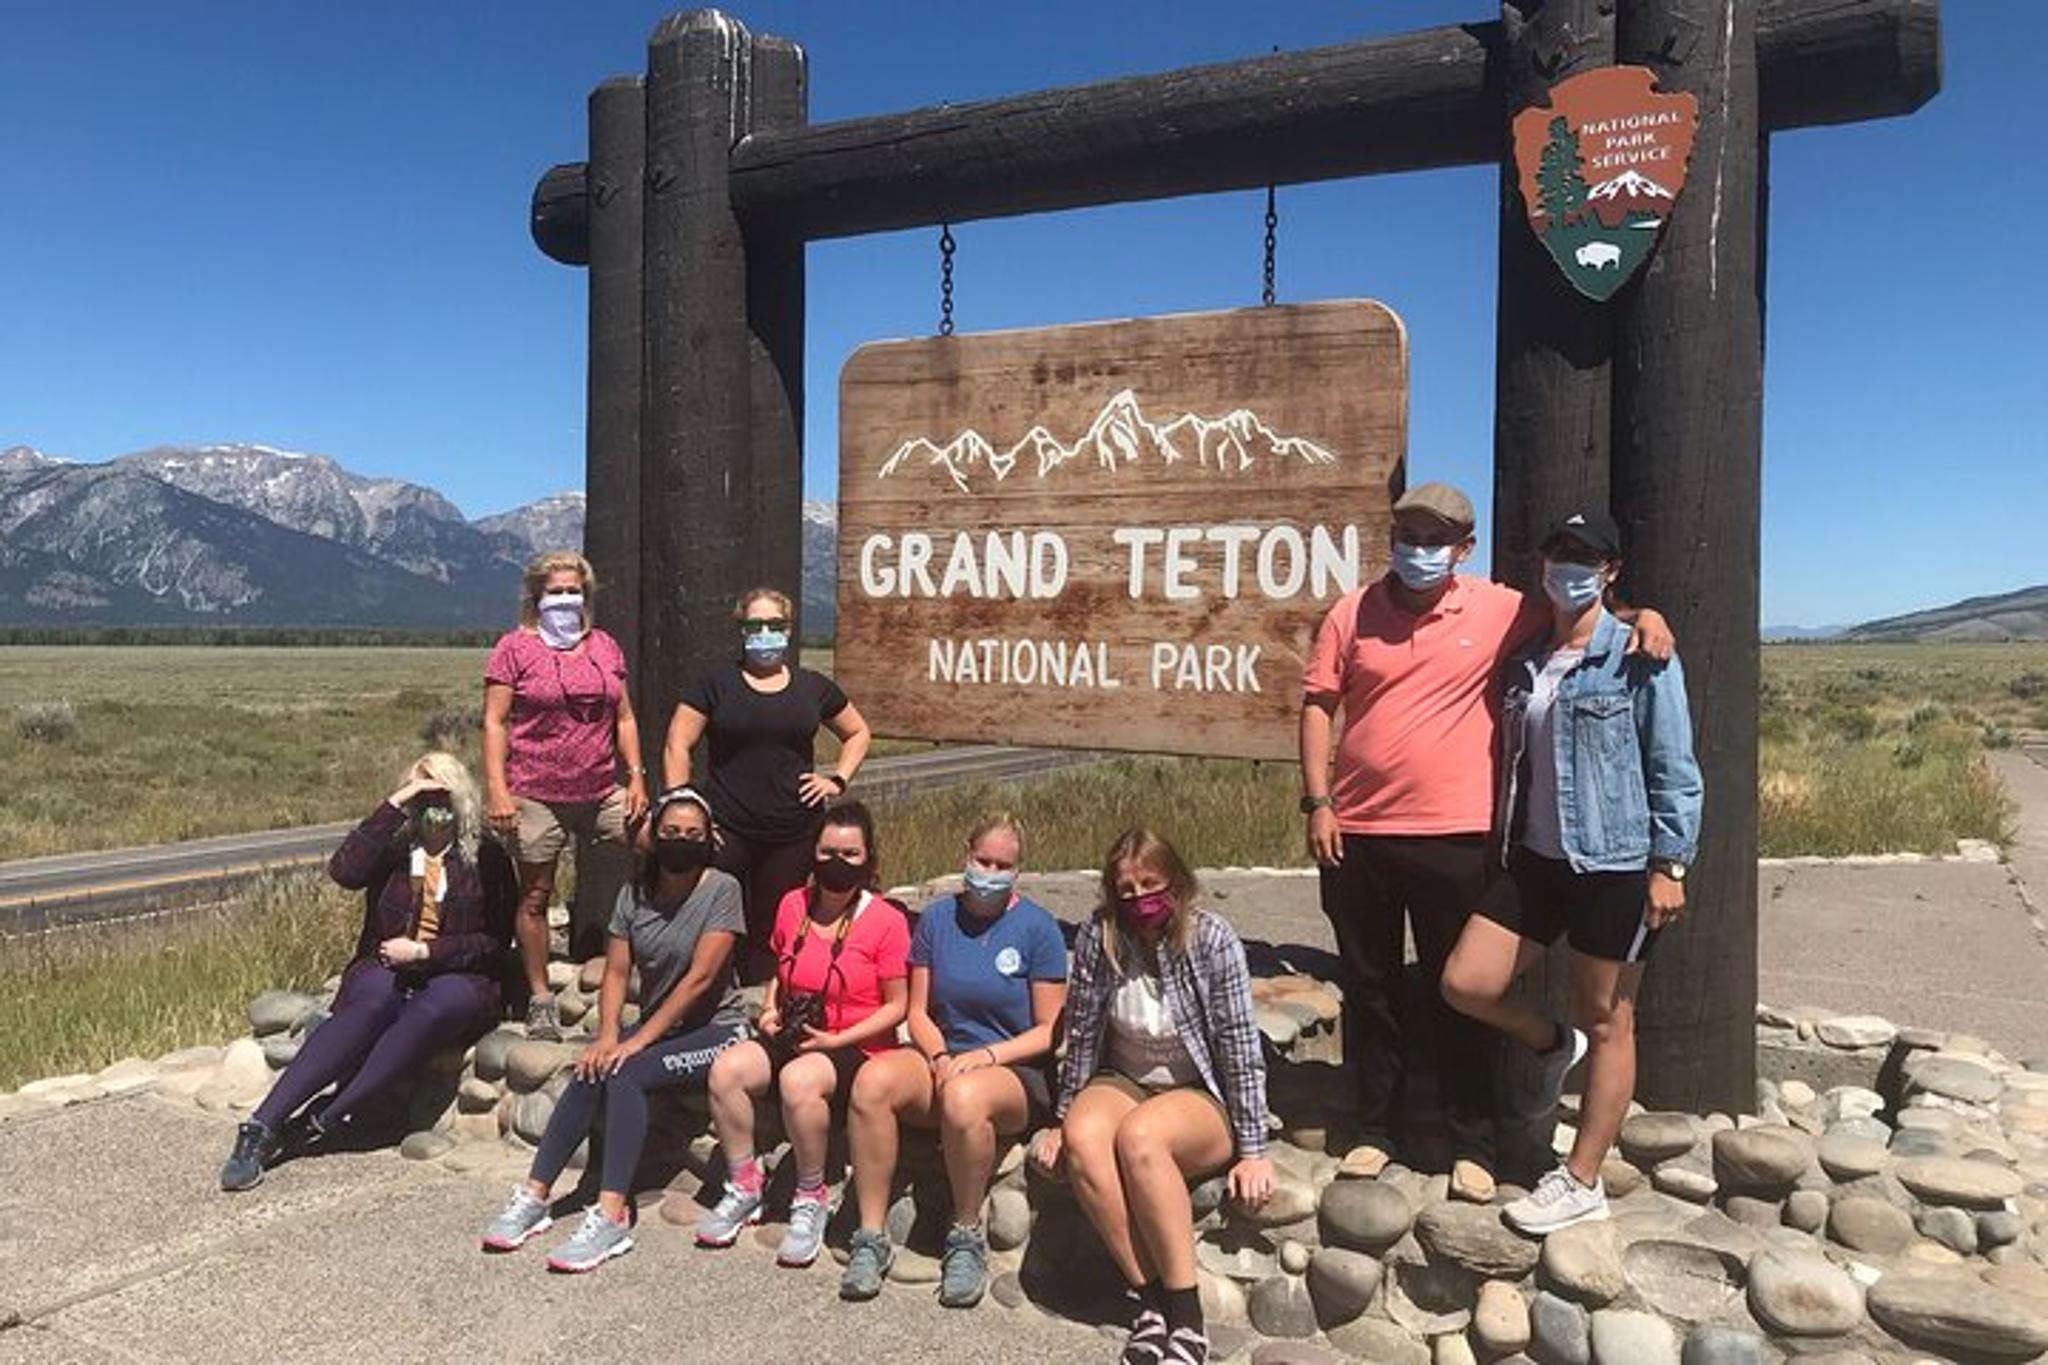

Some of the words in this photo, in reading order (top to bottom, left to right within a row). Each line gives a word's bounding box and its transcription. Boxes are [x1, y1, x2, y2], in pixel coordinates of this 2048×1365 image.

[1582, 111, 1680, 135] NATIONAL
[1605, 132, 1657, 149] PARK
[1591, 147, 1671, 169] SERVICE
[860, 531, 1068, 599] GRAND
[1113, 524, 1359, 600] TETON
[928, 638, 1121, 688] NATIONAL
[1150, 641, 1263, 692] PARK
